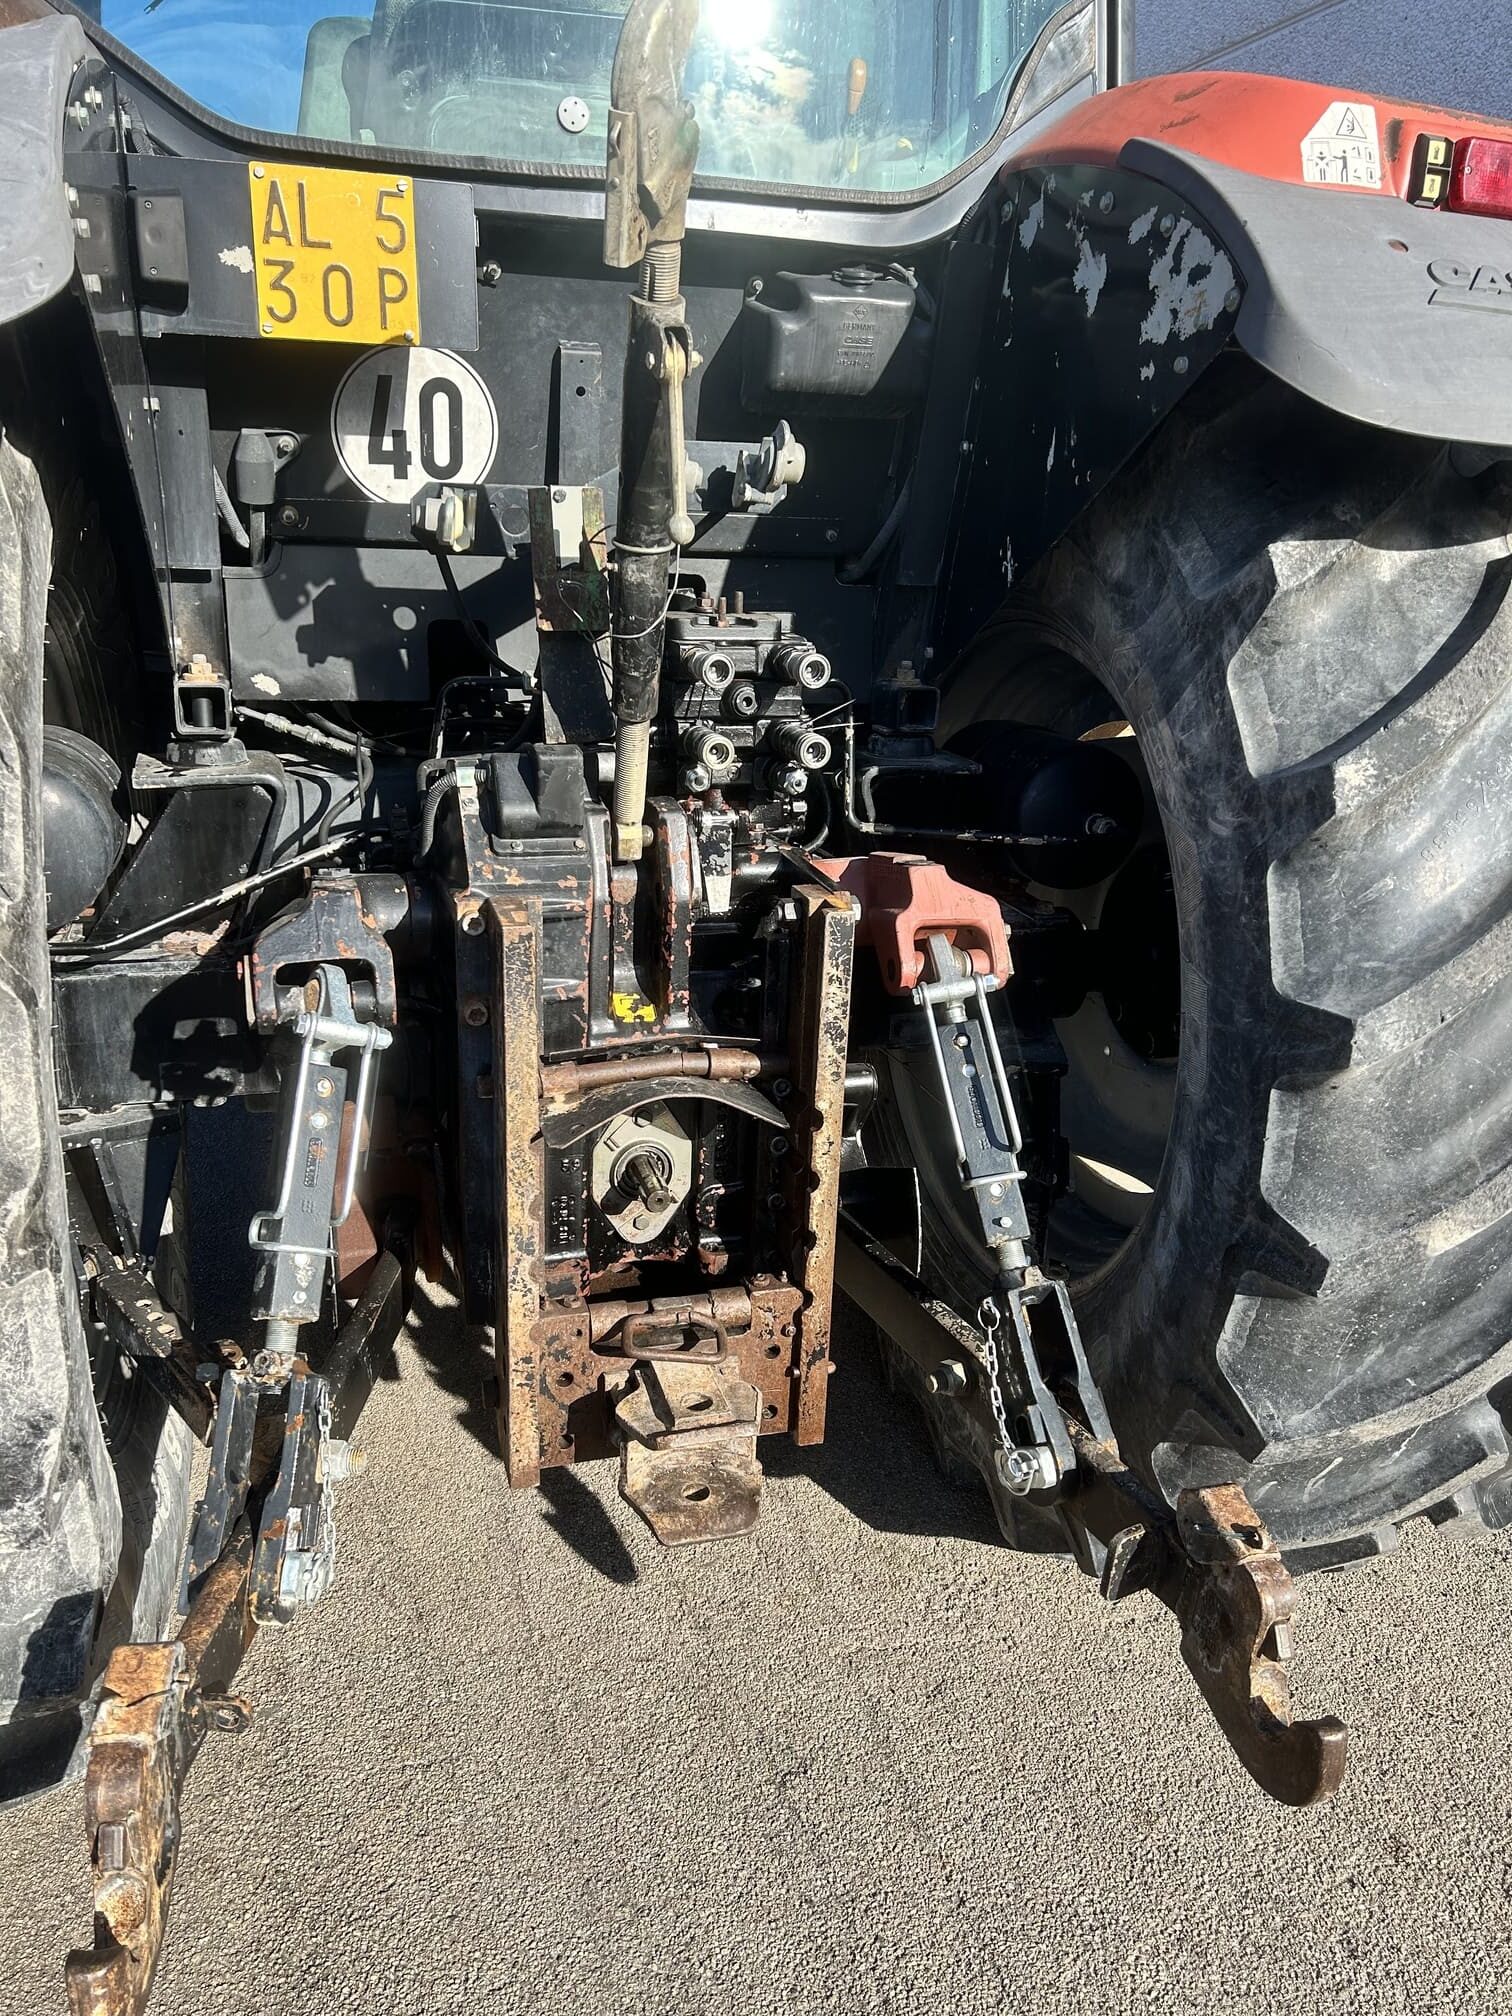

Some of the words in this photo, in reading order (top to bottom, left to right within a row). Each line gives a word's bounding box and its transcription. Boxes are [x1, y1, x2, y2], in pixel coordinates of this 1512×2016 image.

[263, 178, 332, 249] AL
[375, 188, 407, 254] 5
[1426, 259, 1512, 294] CA
[844, 335, 874, 347] CASE
[368, 375, 463, 480] 40
